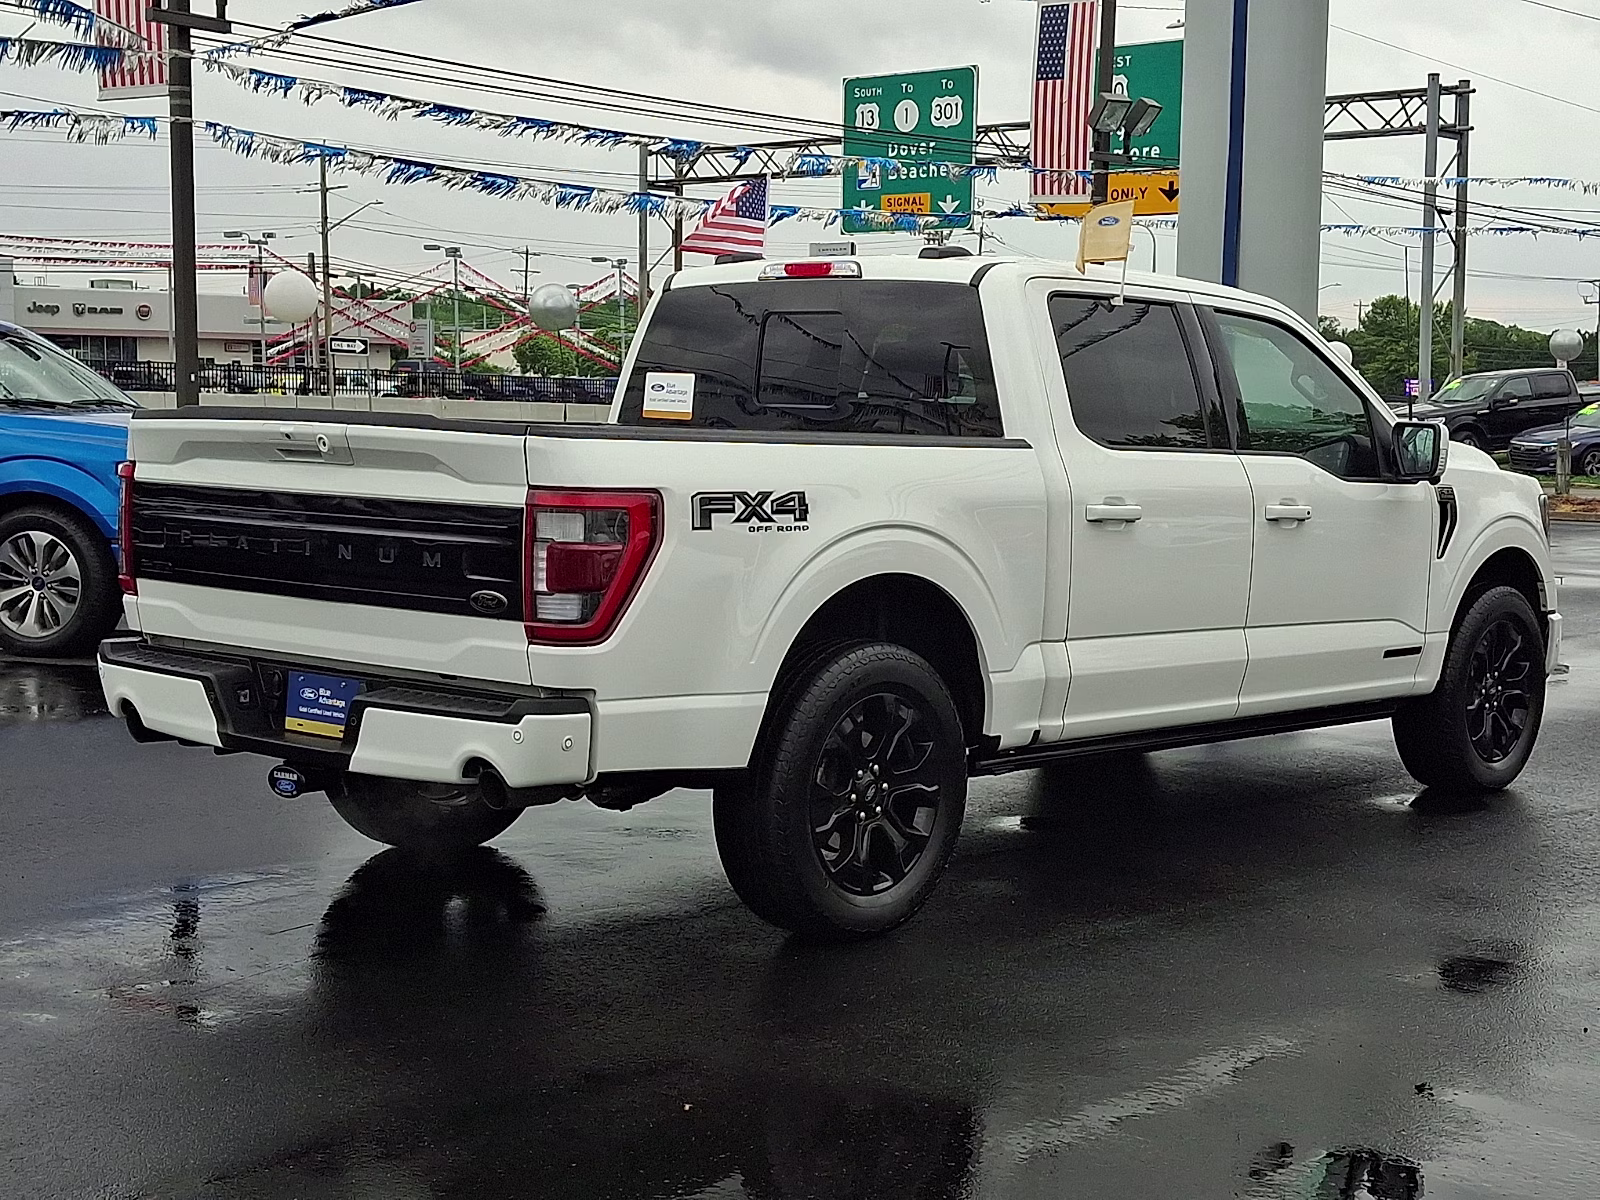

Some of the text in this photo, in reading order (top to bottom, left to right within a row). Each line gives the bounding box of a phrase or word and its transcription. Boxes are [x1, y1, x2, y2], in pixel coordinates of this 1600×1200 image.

[854, 87, 883, 98] SOUTH
[860, 109, 875, 127] 13
[904, 107, 909, 124] 1
[934, 102, 959, 121] 301
[888, 141, 936, 157] Dover
[1110, 186, 1149, 201] ONLY
[886, 196, 925, 208] SIGNAL
[27, 301, 60, 316] Jeep
[690, 491, 809, 531] FX4
[748, 525, 772, 533] OFF
[180, 529, 442, 568] PLATINUM
[474, 592, 502, 610] Ford
